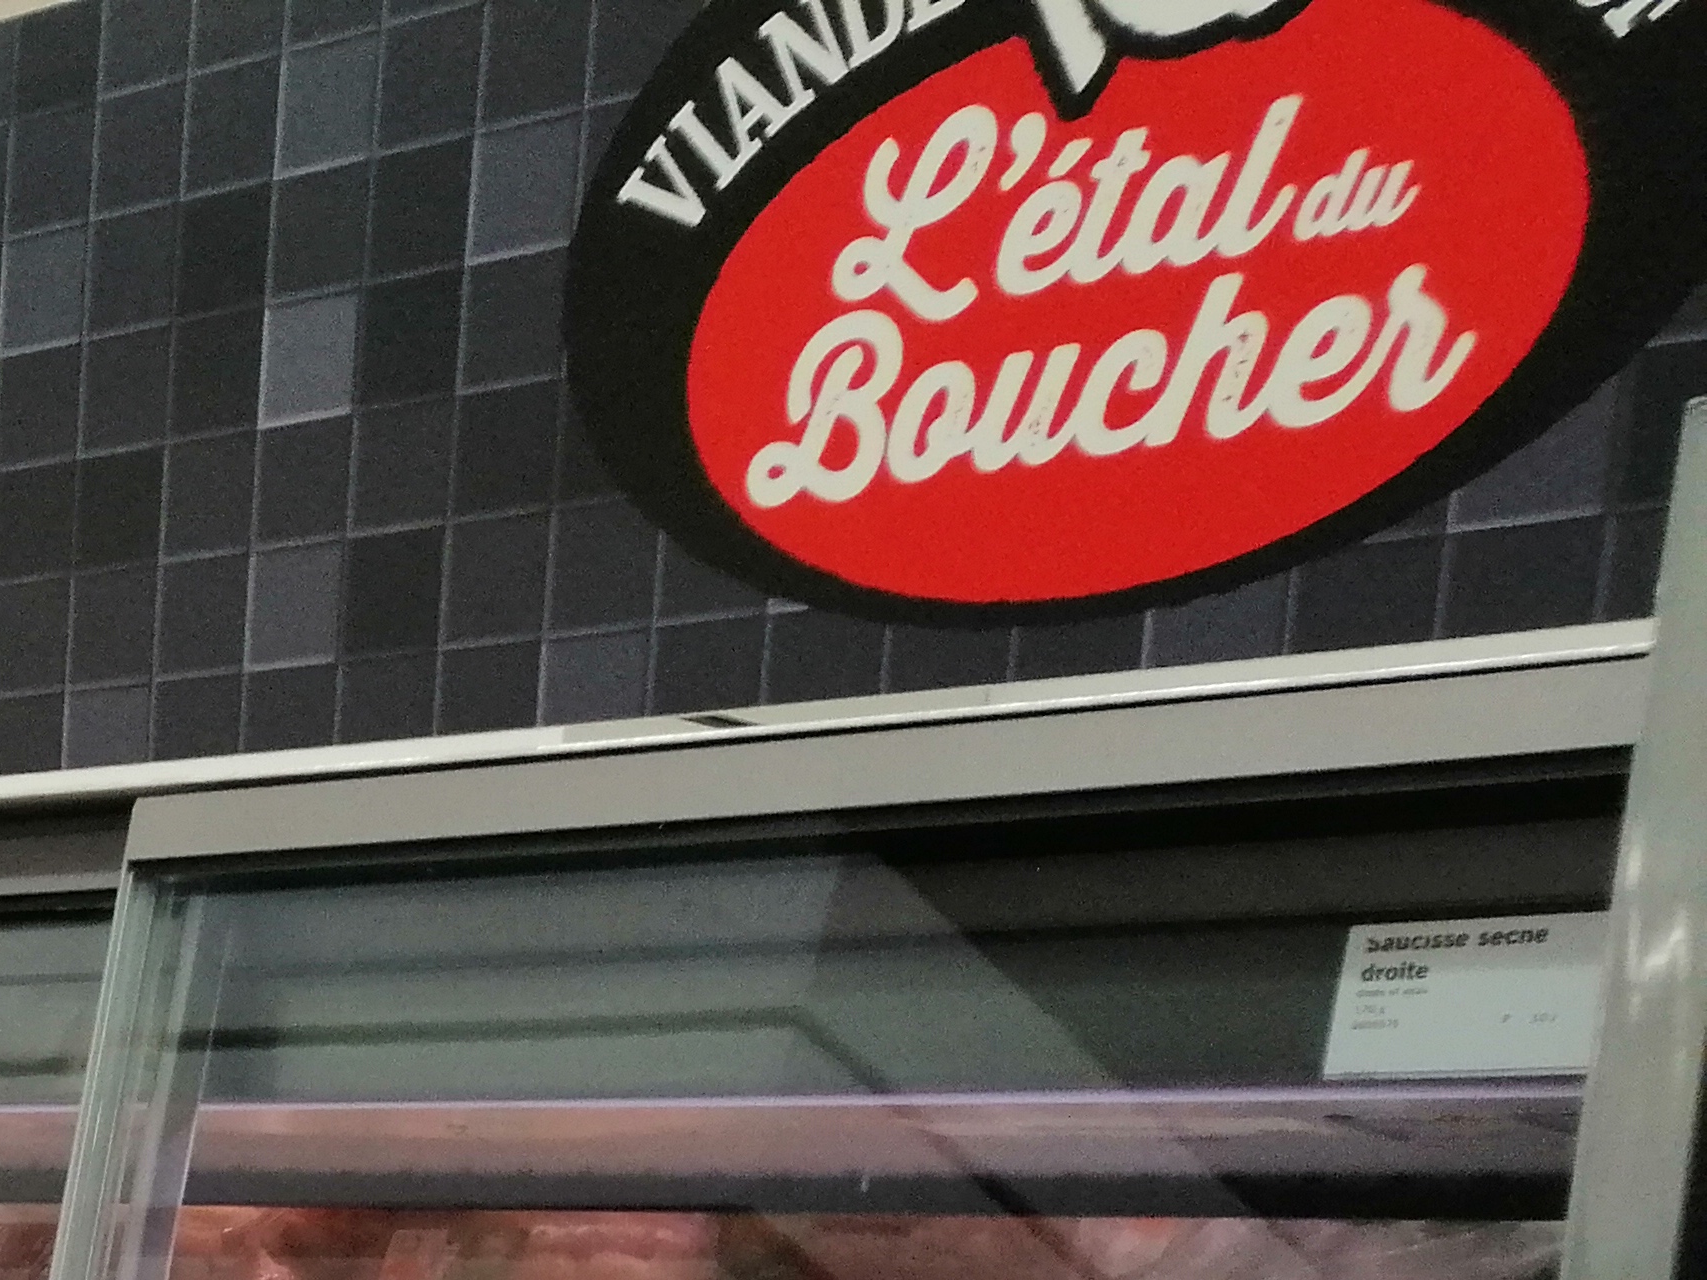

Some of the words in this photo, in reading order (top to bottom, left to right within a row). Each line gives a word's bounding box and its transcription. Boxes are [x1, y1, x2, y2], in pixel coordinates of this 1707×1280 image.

[832, 93, 1305, 321] L'étal
[1293, 148, 1419, 240] du
[744, 262, 1478, 510] Boucher
[1361, 961, 1429, 982] droite
[1366, 930, 1471, 953] Saucisse
